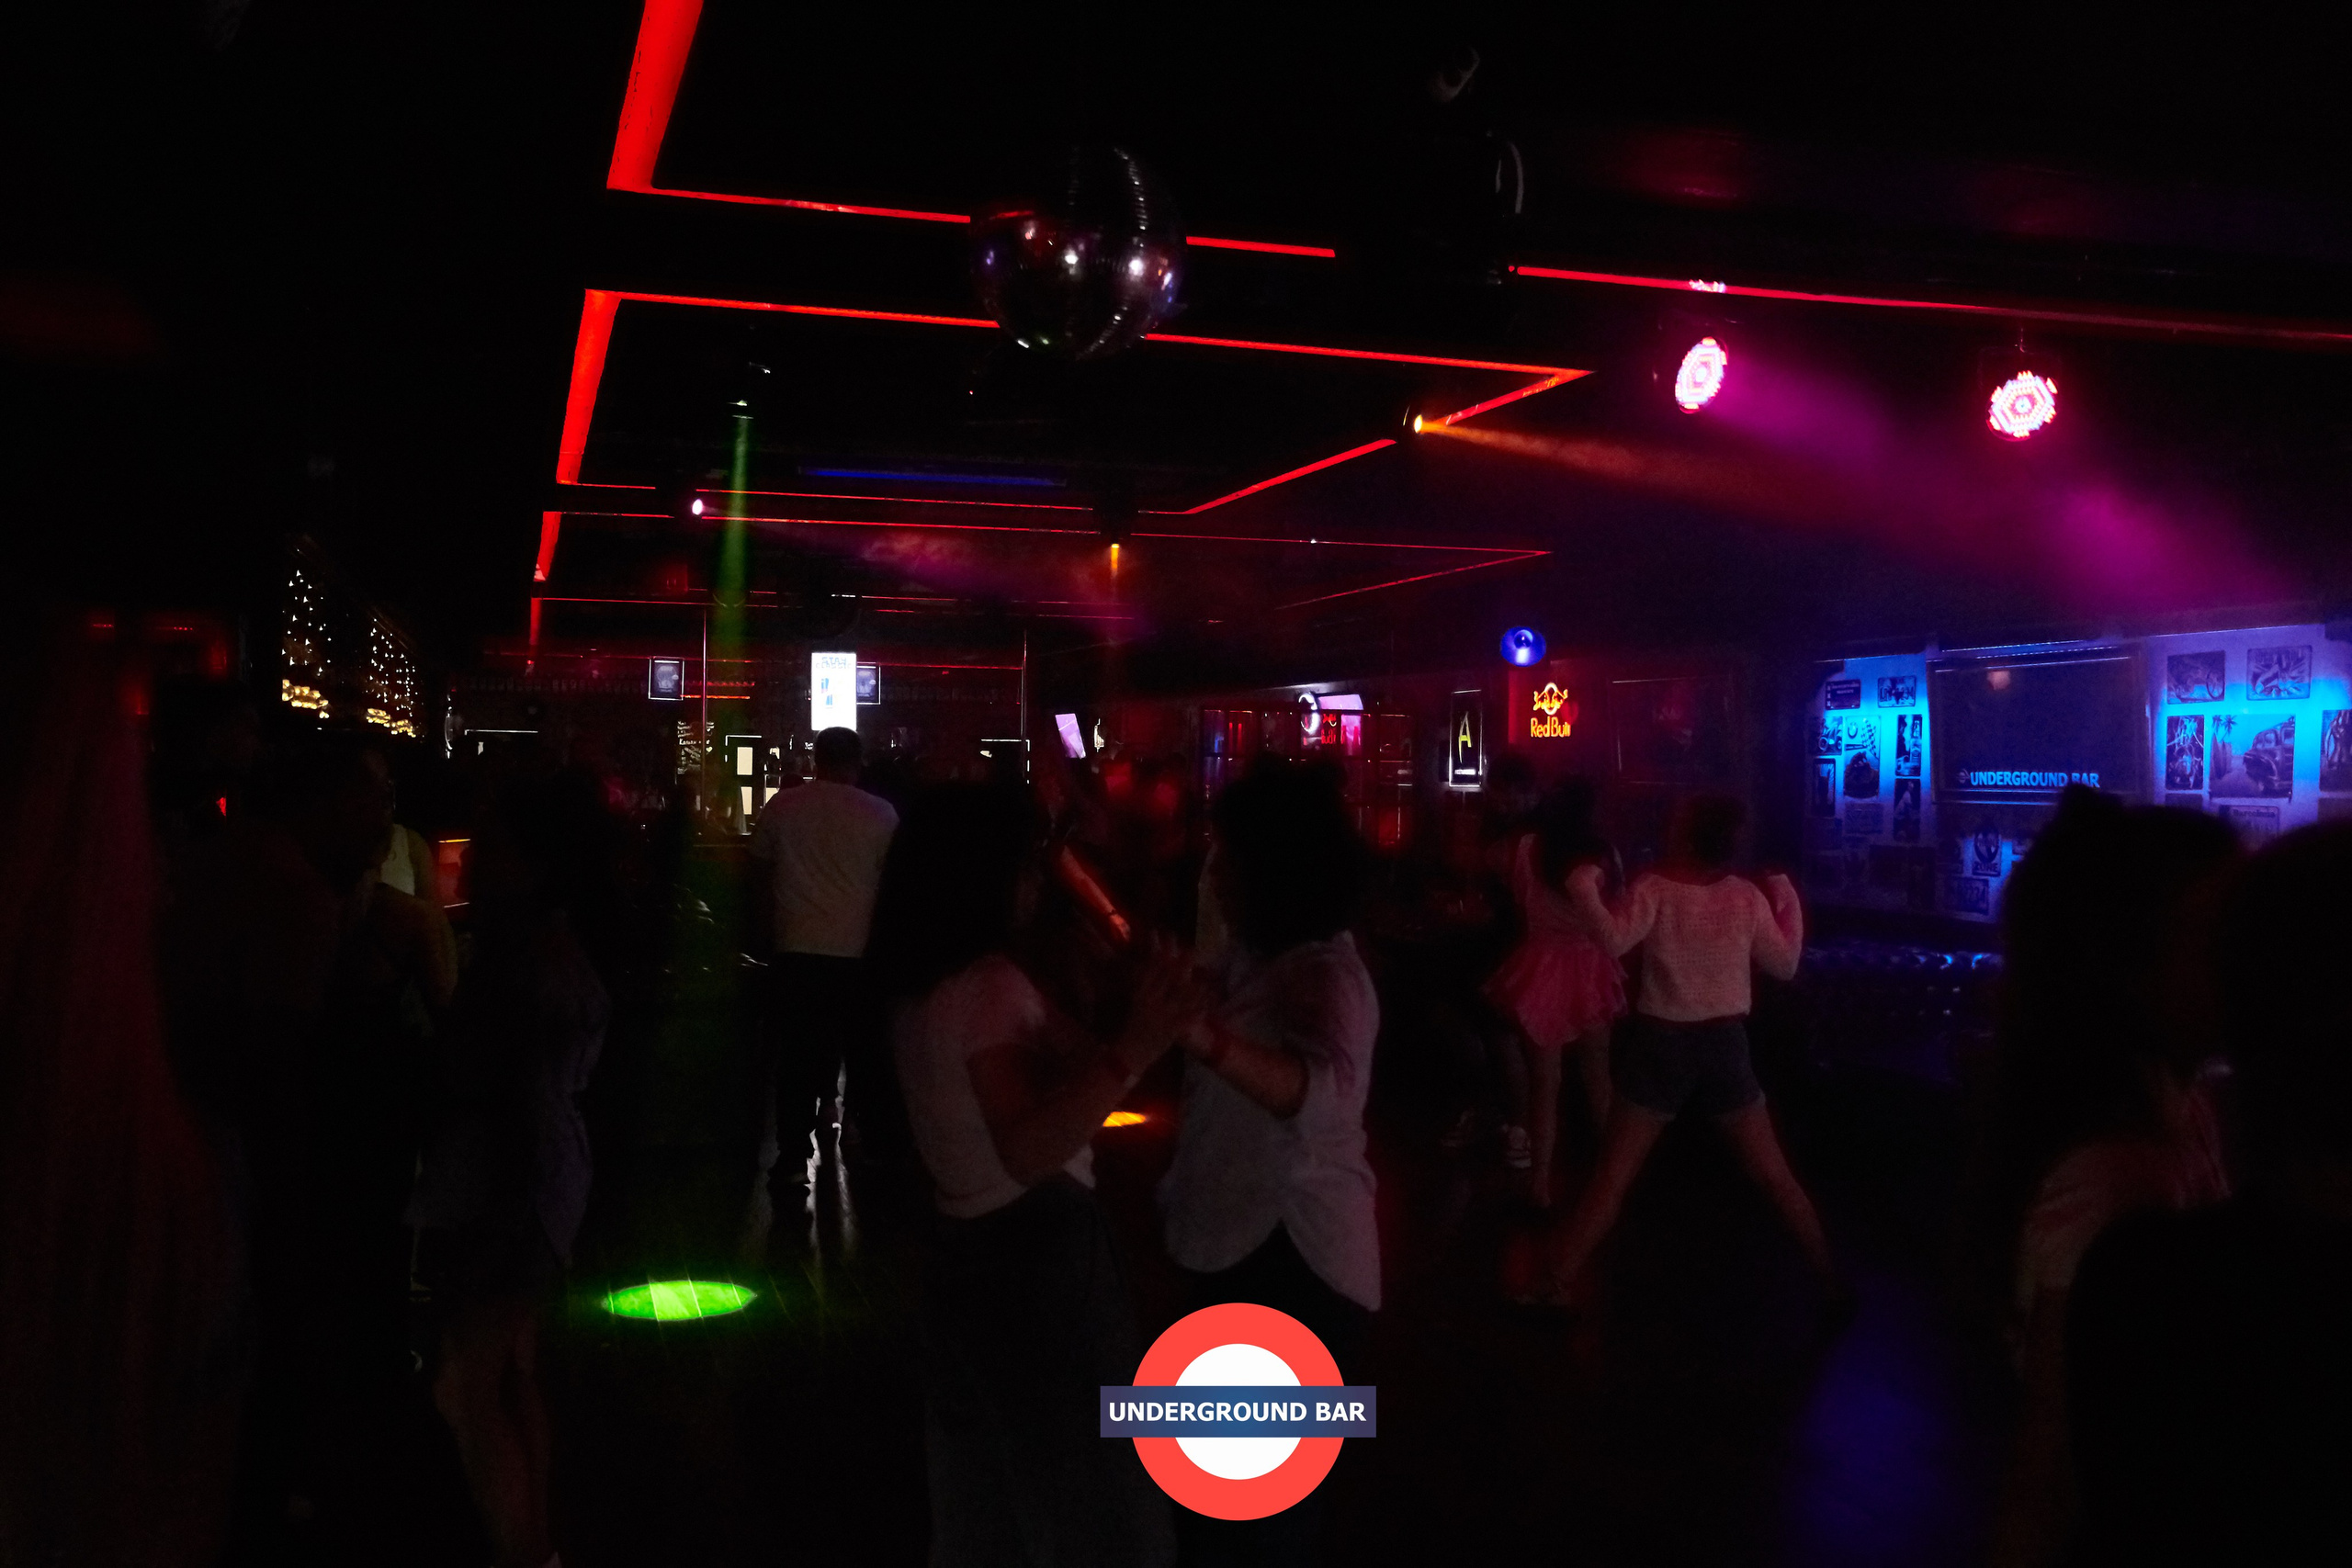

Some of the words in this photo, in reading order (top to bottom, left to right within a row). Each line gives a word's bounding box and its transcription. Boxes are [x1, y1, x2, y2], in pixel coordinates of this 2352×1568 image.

[1530, 716, 1550, 738] Red
[1970, 772, 2068, 787] UNDERGROUND
[2071, 773, 2100, 788] BAR
